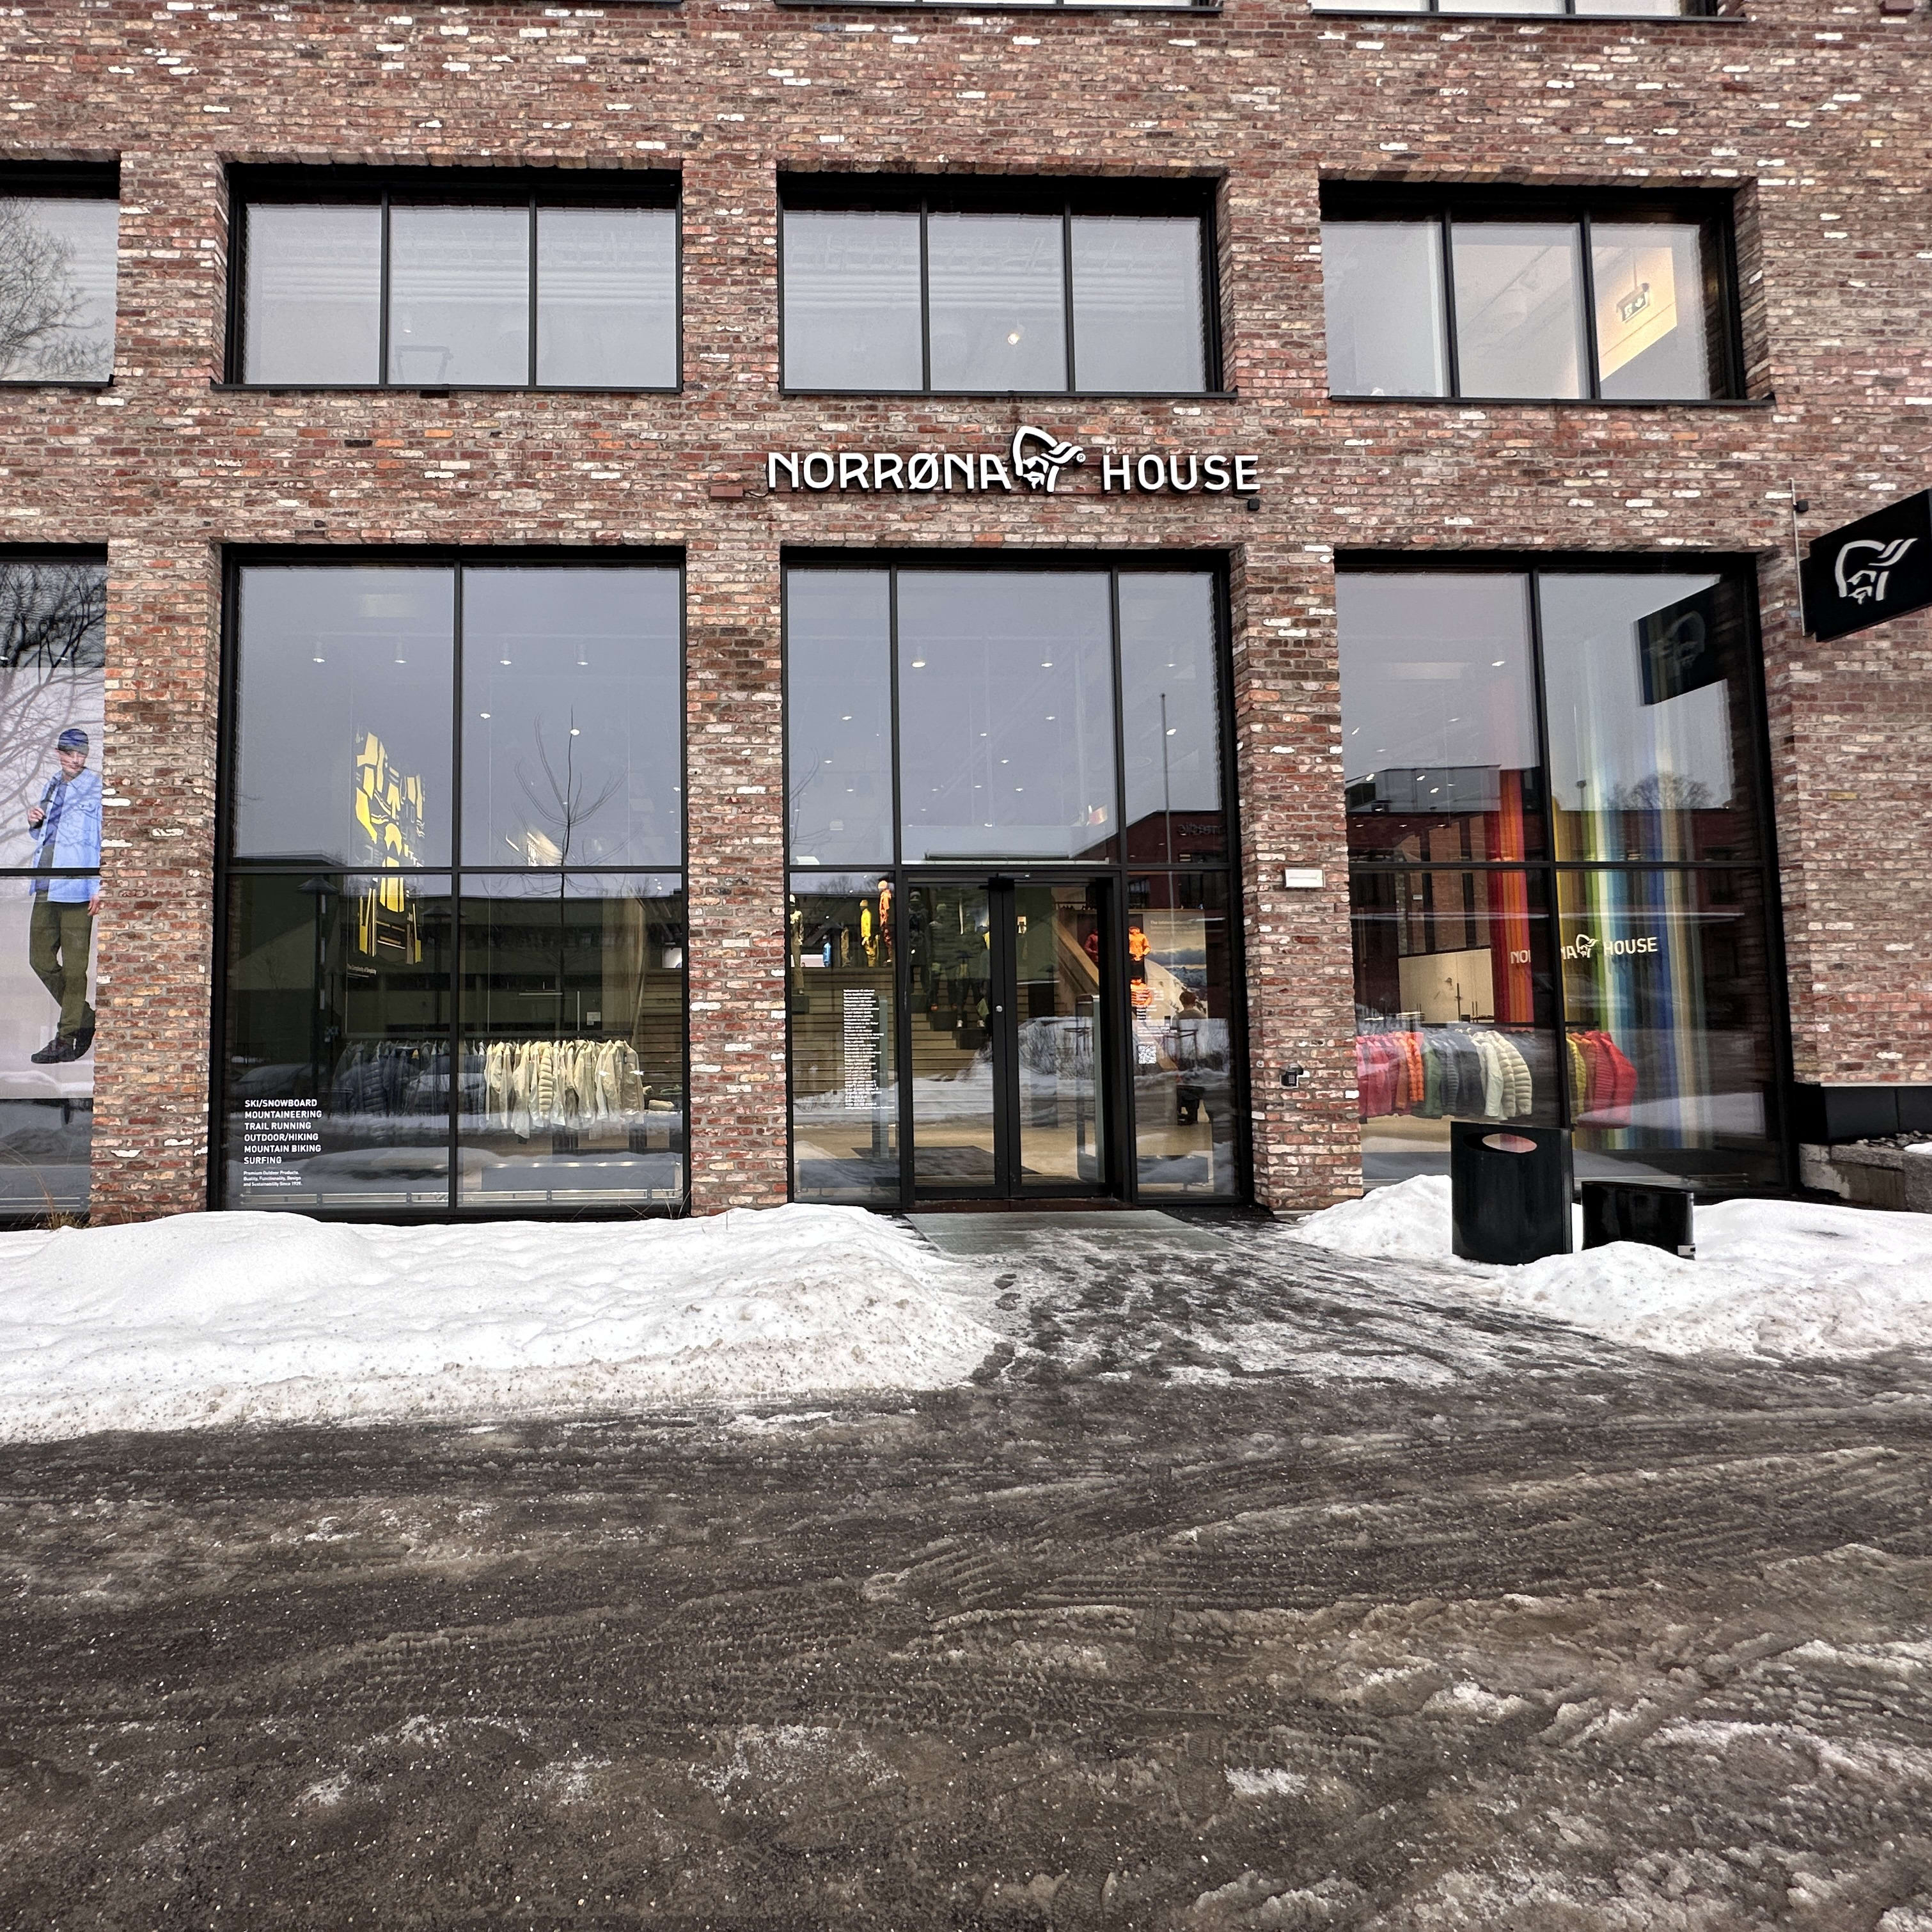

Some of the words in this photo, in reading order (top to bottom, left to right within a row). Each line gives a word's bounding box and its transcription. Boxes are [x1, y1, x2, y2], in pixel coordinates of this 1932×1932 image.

[767, 452, 1012, 491] NORRØNA
[1103, 455, 1261, 490] HOUSE
[1603, 937, 1658, 956] HOUSE
[244, 1099, 317, 1108] SKI/SNOWBOARD
[244, 1110, 322, 1119] MOUNTAINEERING
[271, 1122, 311, 1130] RUNNING
[244, 1133, 318, 1142] OUTDOOR/HIKING
[244, 1145, 289, 1153] MOUNTAIN
